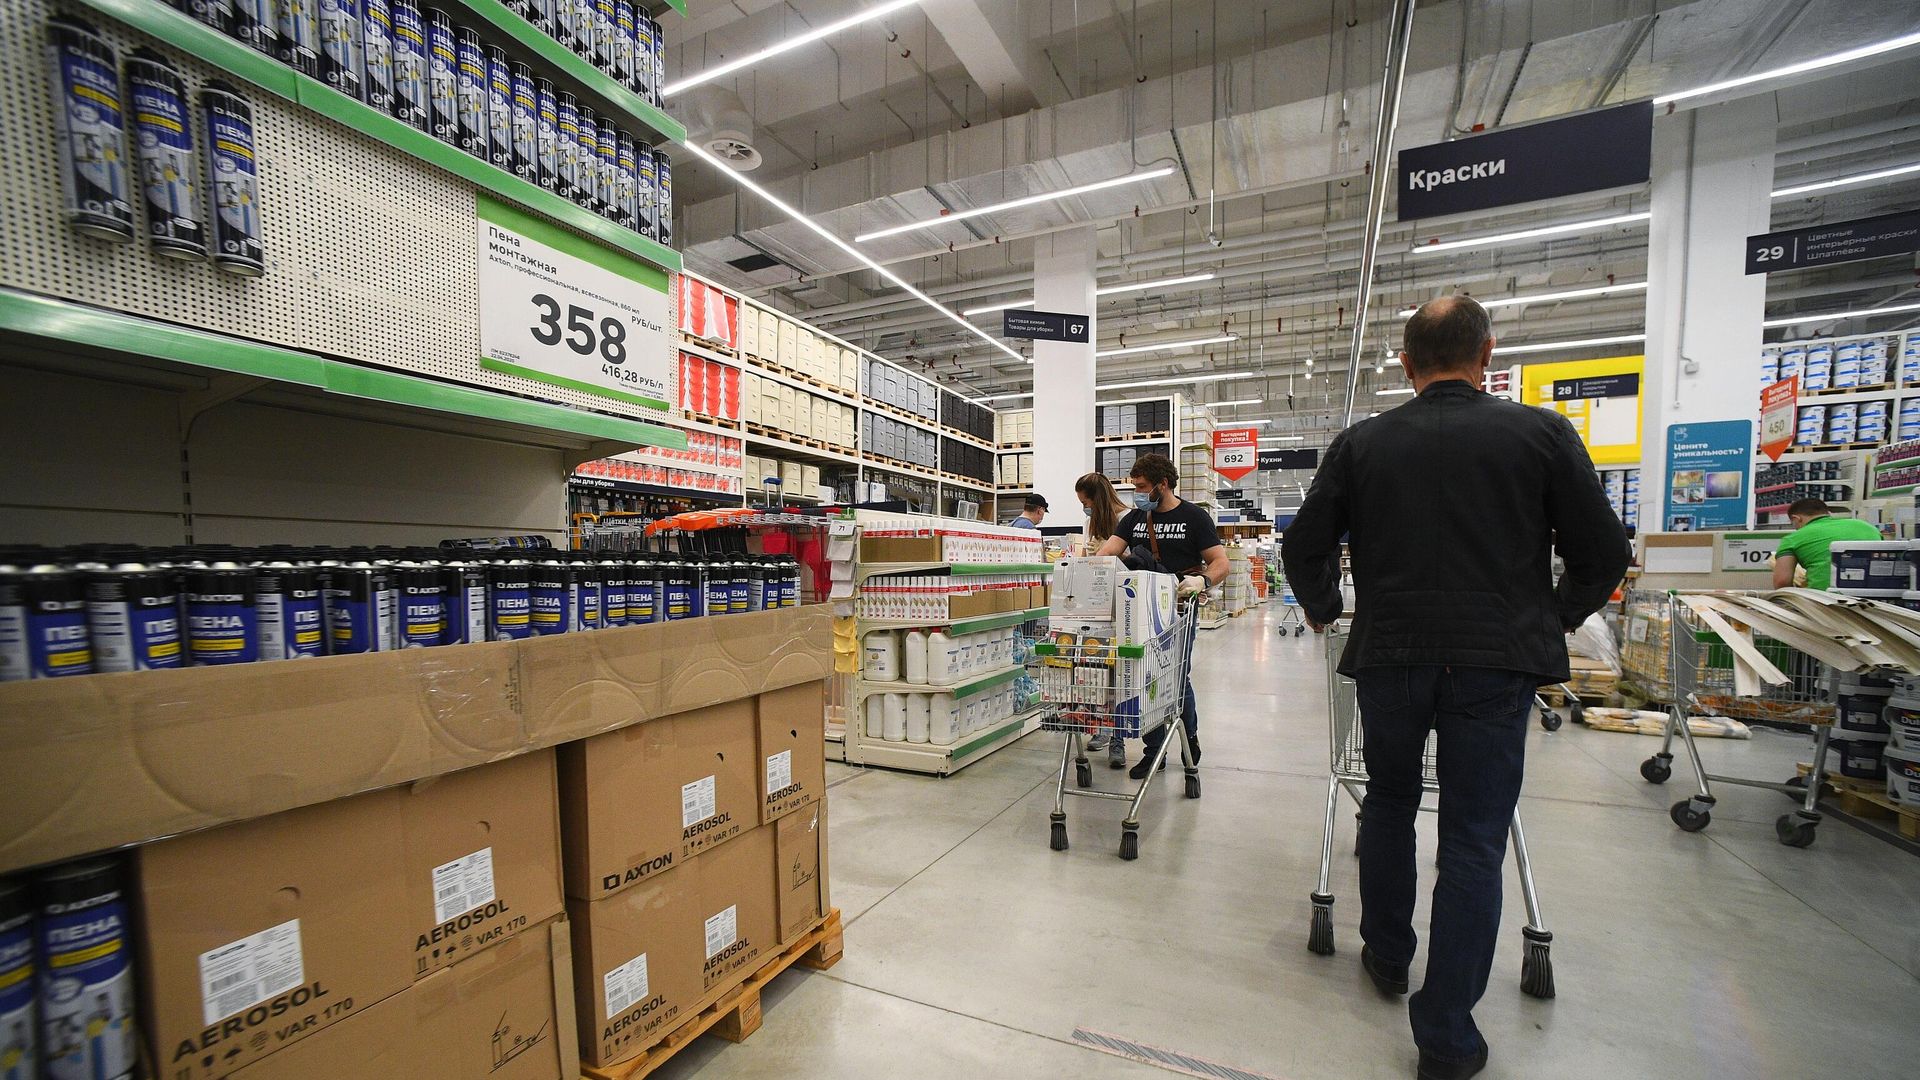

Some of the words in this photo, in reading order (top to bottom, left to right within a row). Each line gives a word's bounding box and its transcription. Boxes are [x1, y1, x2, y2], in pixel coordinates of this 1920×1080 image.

[1408, 158, 1506, 191] Краски
[489, 225, 521, 248] Пена
[1806, 235, 1876, 251] интерьерные
[1878, 228, 1918, 241] краски
[1808, 229, 1854, 242] Цветные
[489, 241, 557, 275] монтажная
[1756, 245, 1784, 262] 29
[489, 254, 513, 269] Axton,
[514, 263, 581, 294] профессиональная,
[530, 293, 627, 365] 358
[631, 315, 663, 334] РУБ/шт.
[1070, 324, 1084, 335] 67
[601, 363, 638, 383] 416,28
[639, 376, 664, 390] РУБ/л
[1558, 385, 1572, 396] 28
[1673, 442, 1709, 451] Цените
[1673, 447, 1744, 459] уникальность?
[1224, 454, 1244, 463] 692
[1260, 457, 1283, 465] Кухни
[594, 480, 615, 488] уборки
[838, 524, 846, 532] 71
[1132, 522, 1187, 533] AUHENTIC
[419, 586, 440, 594] AXTO
[627, 593, 653, 602] ПЕНА
[710, 591, 728, 599] ЕНА
[497, 598, 529, 609] ПЕНА
[532, 597, 561, 607] ПЕНА
[190, 616, 245, 629] ПЕНА
[1904, 768, 1920, 778] Du
[766, 781, 803, 805] AEROSOL
[789, 797, 801, 809] VAR
[801, 794, 810, 804] 170
[683, 812, 731, 840] AEROSOL
[712, 830, 728, 843] VAR
[728, 825, 740, 838] 170
[624, 851, 673, 884] AXTON
[48, 915, 121, 943] ПЕНА
[415, 899, 510, 952] AEROSOL
[476, 925, 504, 945] VAR
[506, 915, 527, 933] 170
[703, 937, 750, 973] AEROSOL
[732, 956, 746, 969] VAR
[746, 948, 758, 963] 170
[172, 981, 330, 1063] AEROSOL
[275, 1008, 318, 1042] VAR
[322, 997, 355, 1020] 170
[603, 994, 667, 1041] AEROSOL
[643, 1015, 663, 1033] VAR
[663, 1005, 678, 1021] 170
